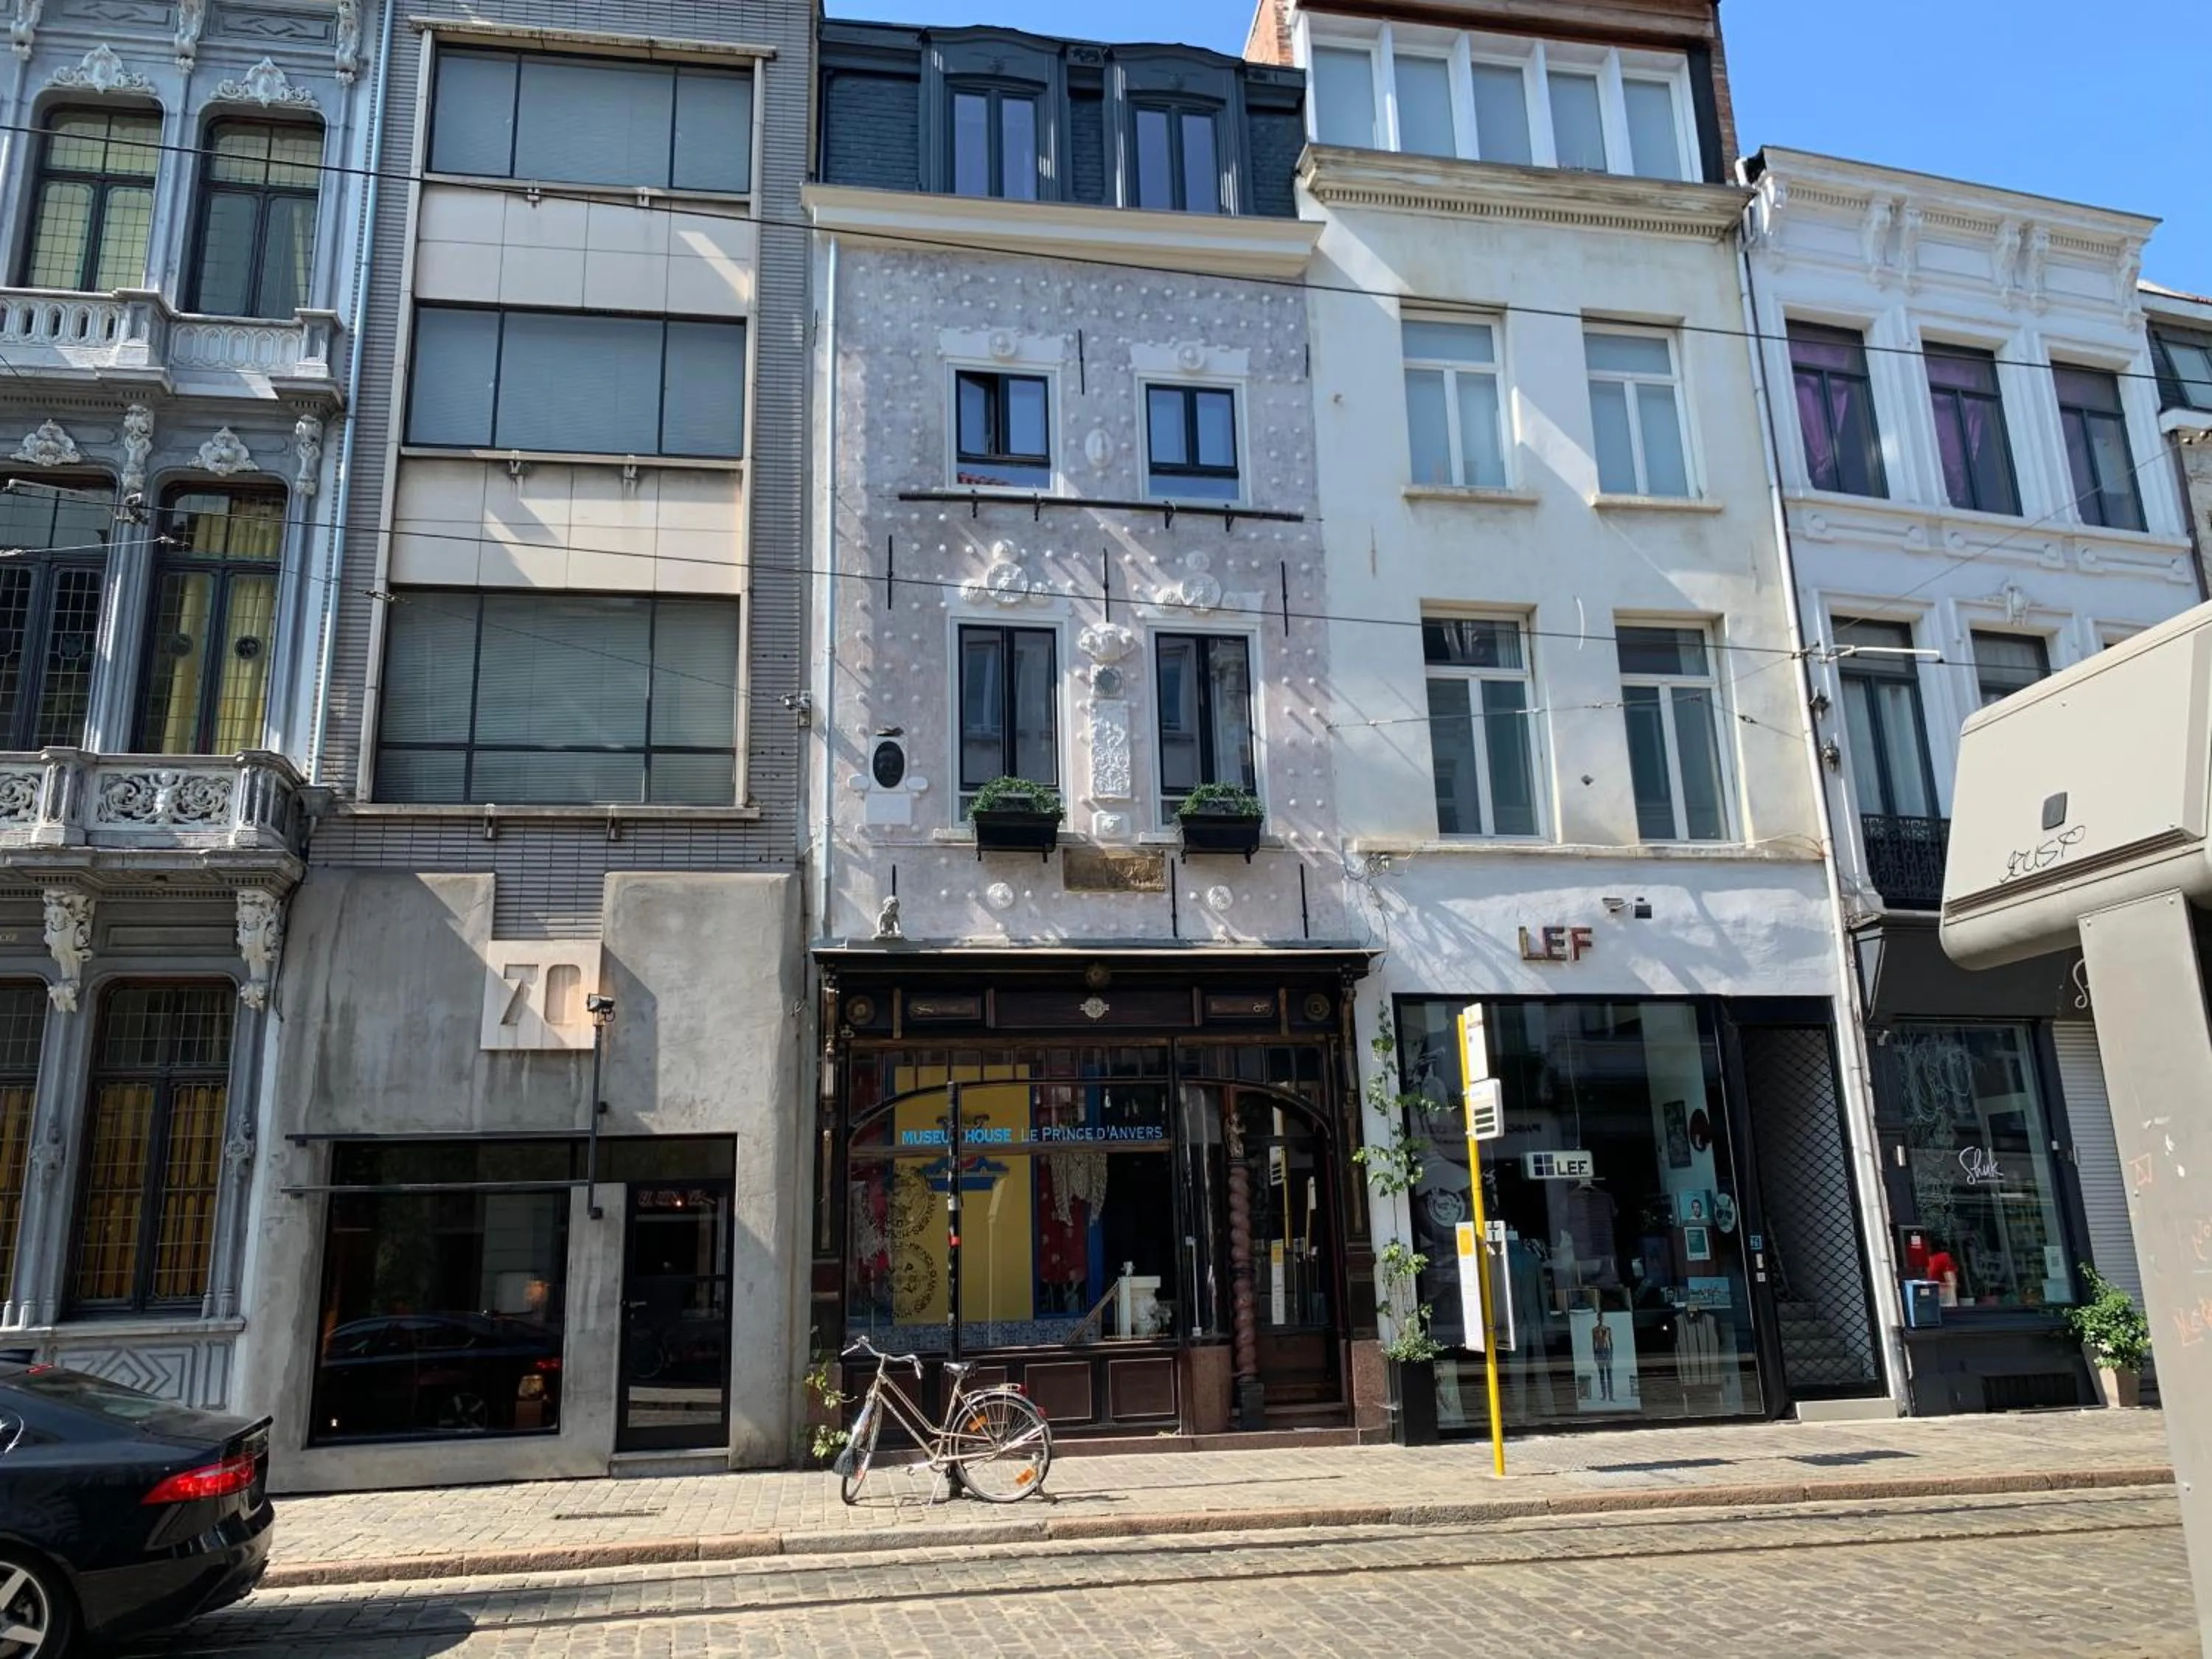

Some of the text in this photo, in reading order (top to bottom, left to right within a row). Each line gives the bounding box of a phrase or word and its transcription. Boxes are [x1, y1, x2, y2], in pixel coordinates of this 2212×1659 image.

[1519, 926, 1593, 961] LEF
[500, 964, 582, 1026] 70
[902, 1130, 953, 1144] MUSEU
[964, 1127, 1012, 1144] HOUSE
[1042, 1126, 1094, 1141] PRINCE
[1096, 1125, 1163, 1140] D'ANVERS
